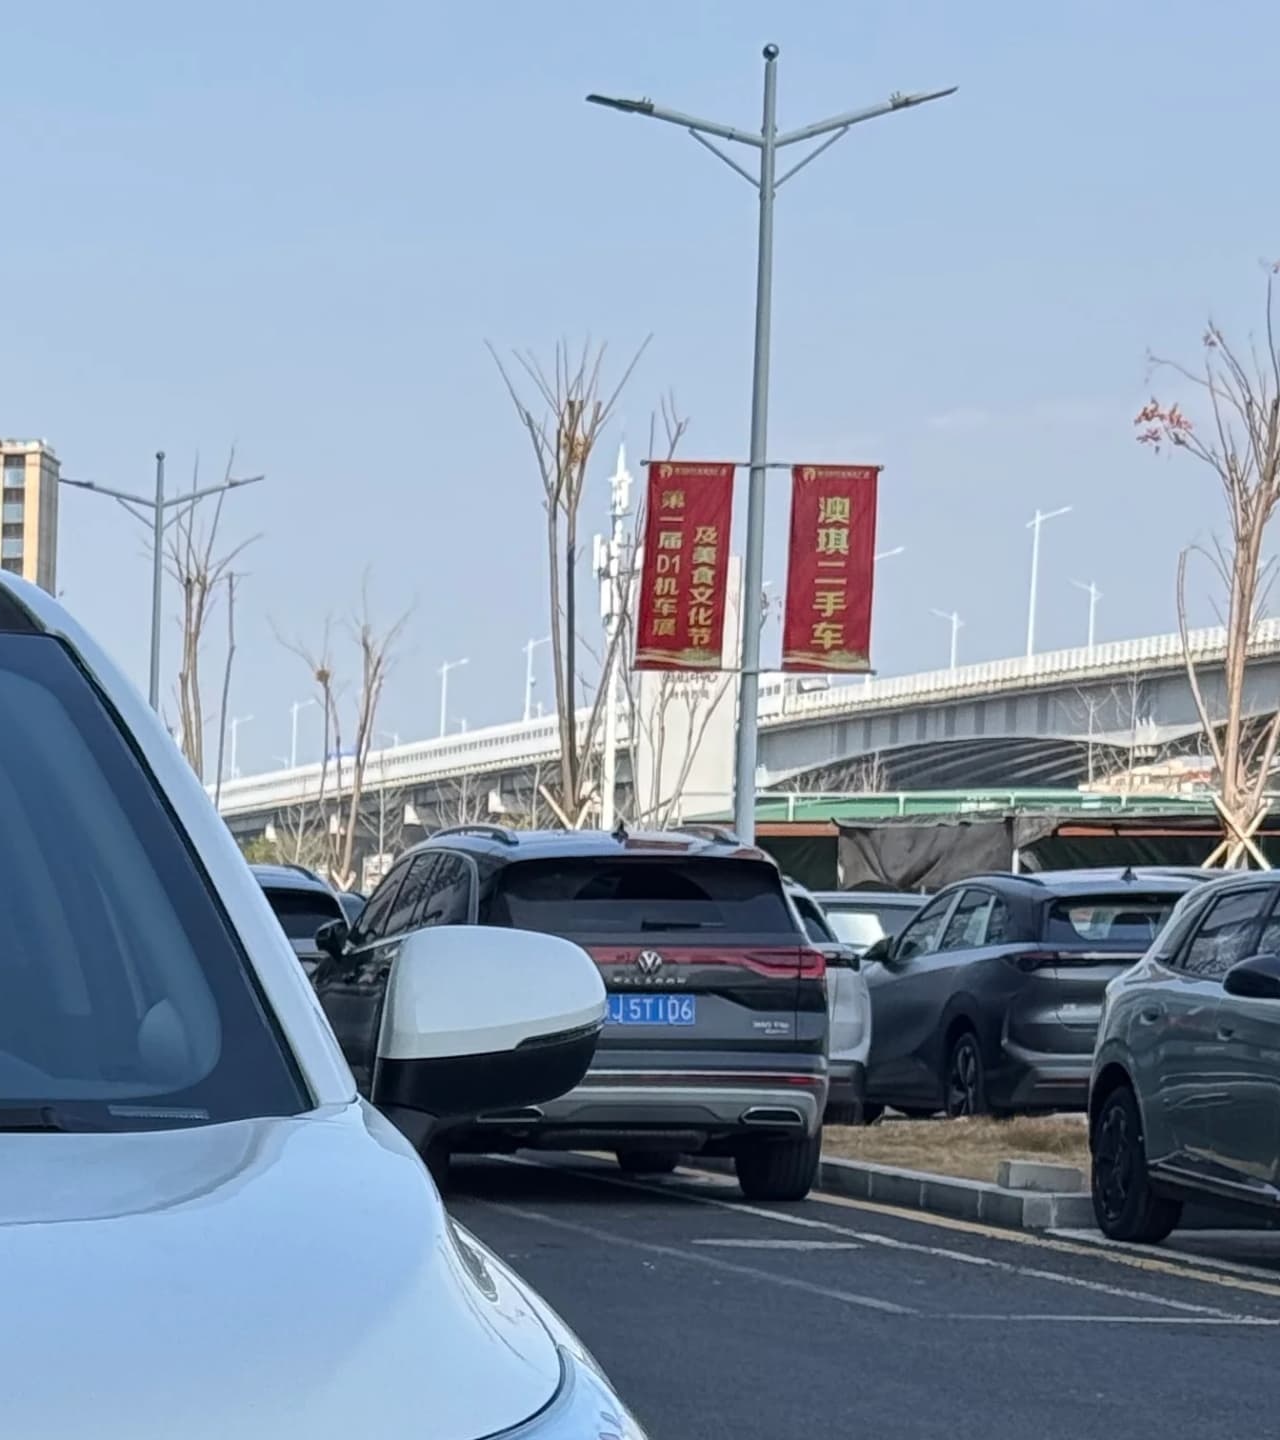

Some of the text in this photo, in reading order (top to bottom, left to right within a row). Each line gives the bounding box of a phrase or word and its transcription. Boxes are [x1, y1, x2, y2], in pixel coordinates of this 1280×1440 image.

[652, 490, 686, 636] 第一届D1机车展
[687, 525, 719, 646] 及美食文化节
[809, 496, 851, 650] 澳琪二手车
[606, 998, 692, 1020] J5T106
